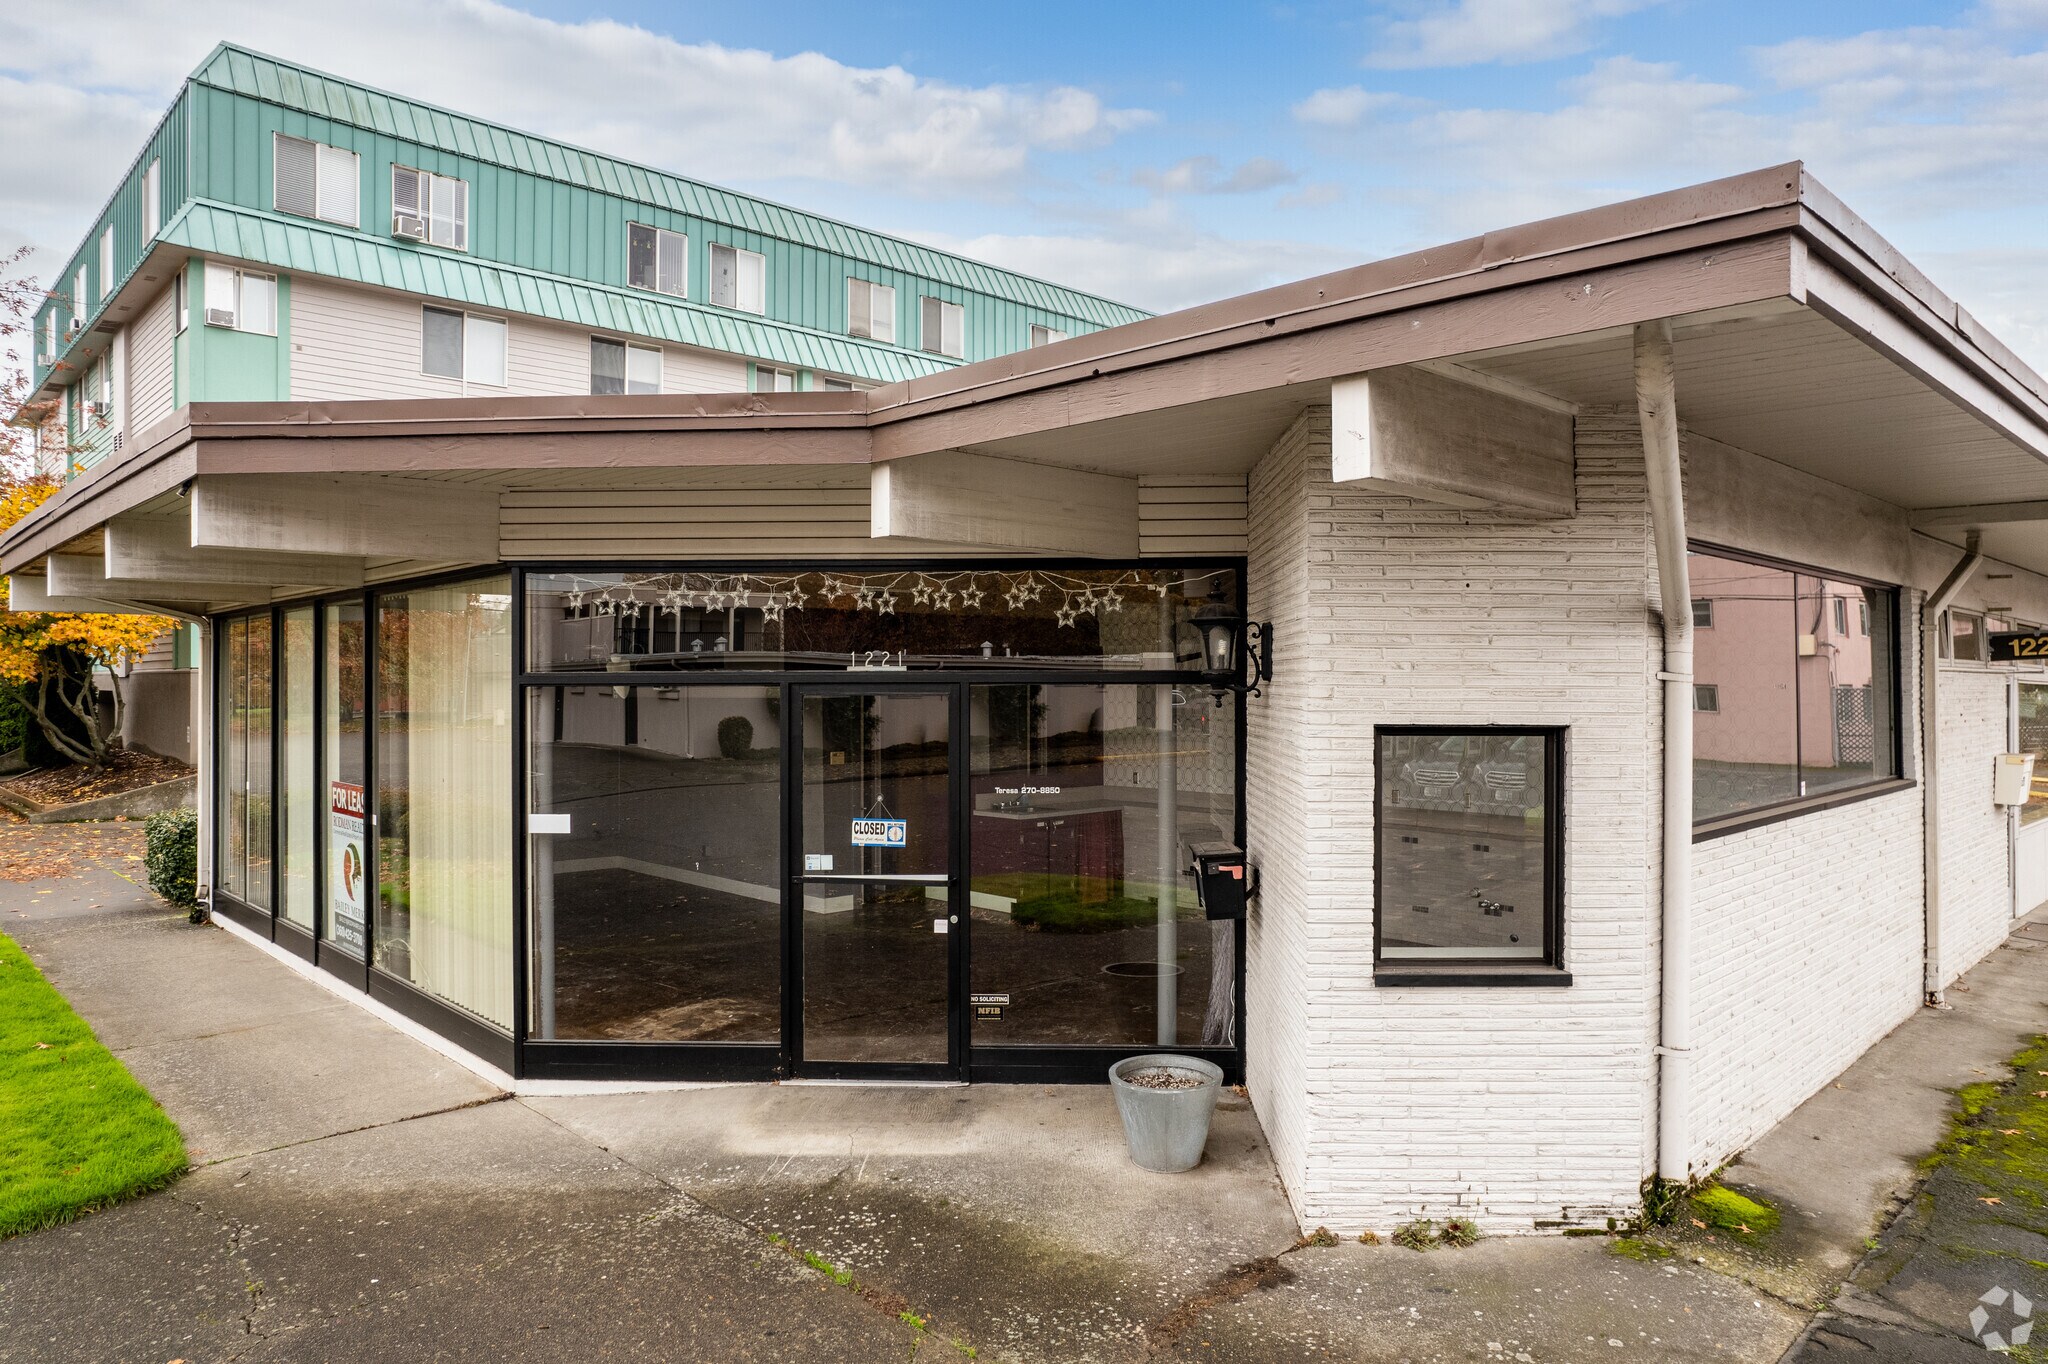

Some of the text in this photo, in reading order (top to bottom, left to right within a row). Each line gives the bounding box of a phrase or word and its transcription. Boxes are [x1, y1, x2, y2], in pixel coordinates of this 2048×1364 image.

[850, 651, 902, 668] 1221
[995, 786, 1061, 794] Teresa 270-8850
[333, 786, 347, 810] FOR
[854, 822, 885, 835] CLOSED
